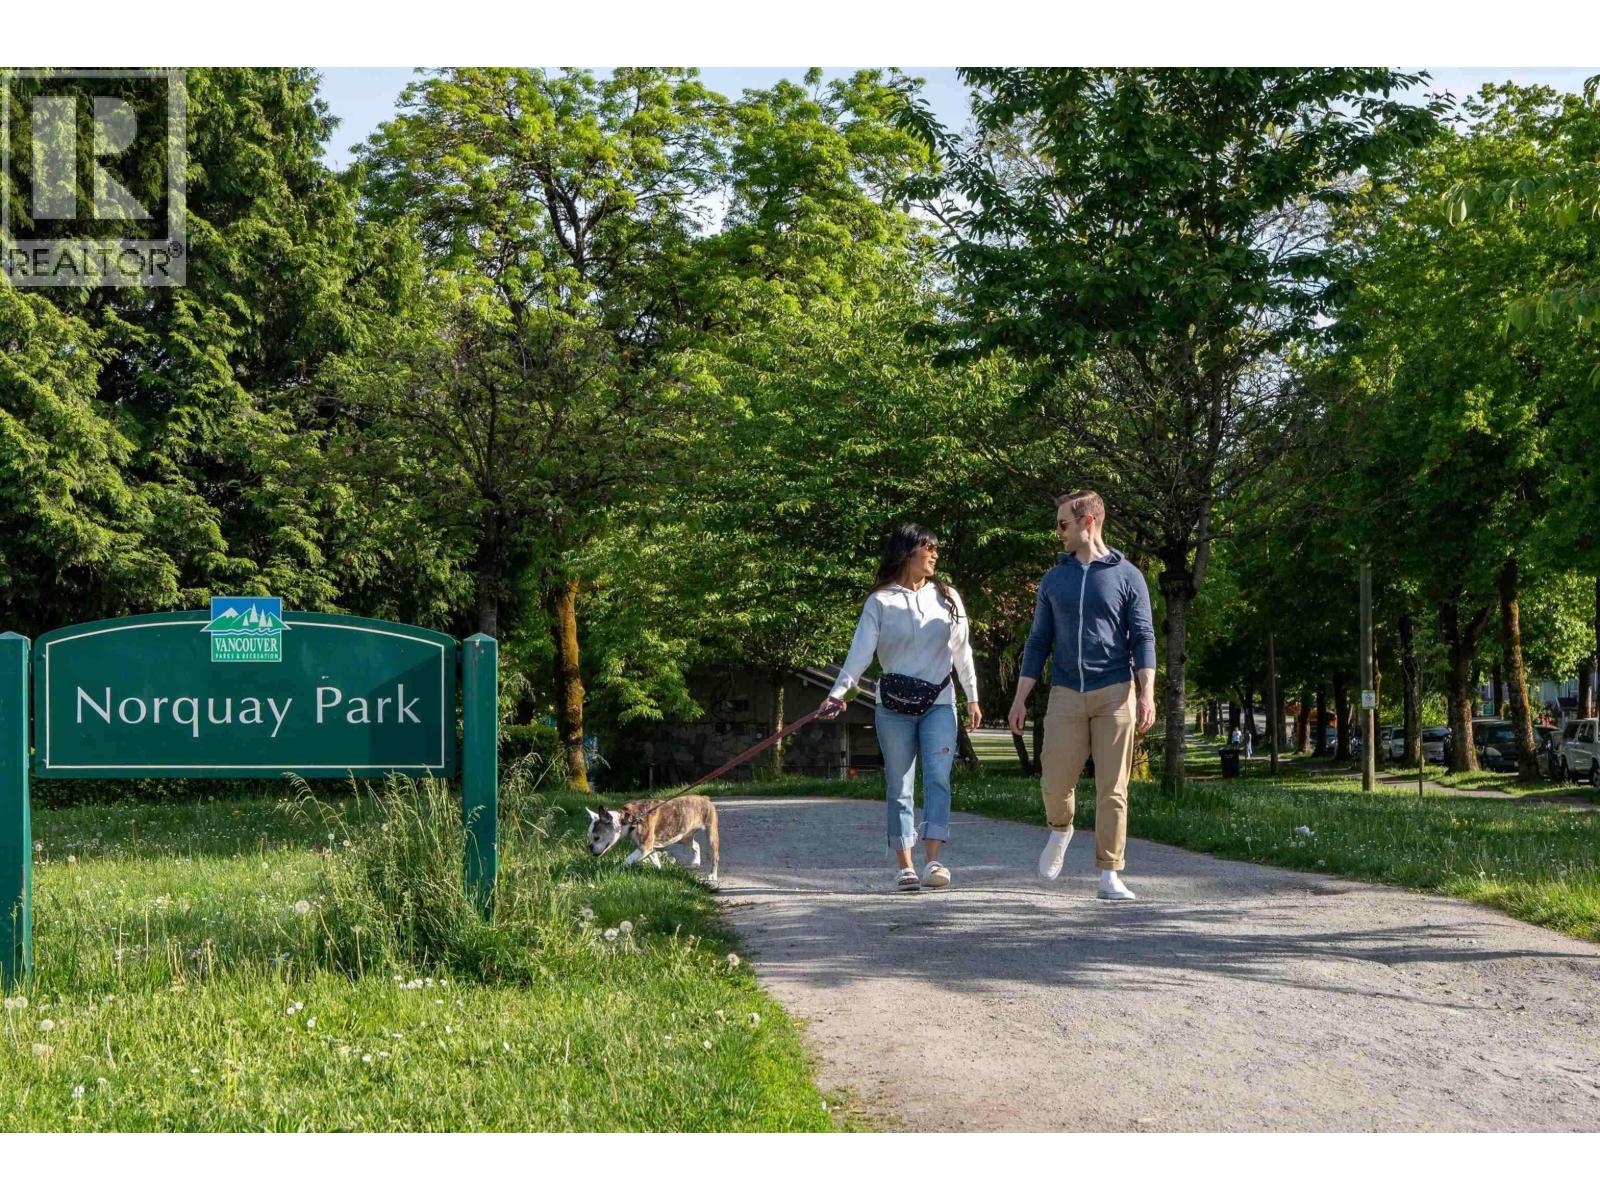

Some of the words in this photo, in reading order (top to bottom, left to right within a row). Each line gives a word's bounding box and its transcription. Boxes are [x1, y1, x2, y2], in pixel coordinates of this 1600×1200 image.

[215, 637, 278, 652] VANCOUVER
[76, 686, 293, 738] Norquay
[315, 683, 422, 724] Park
